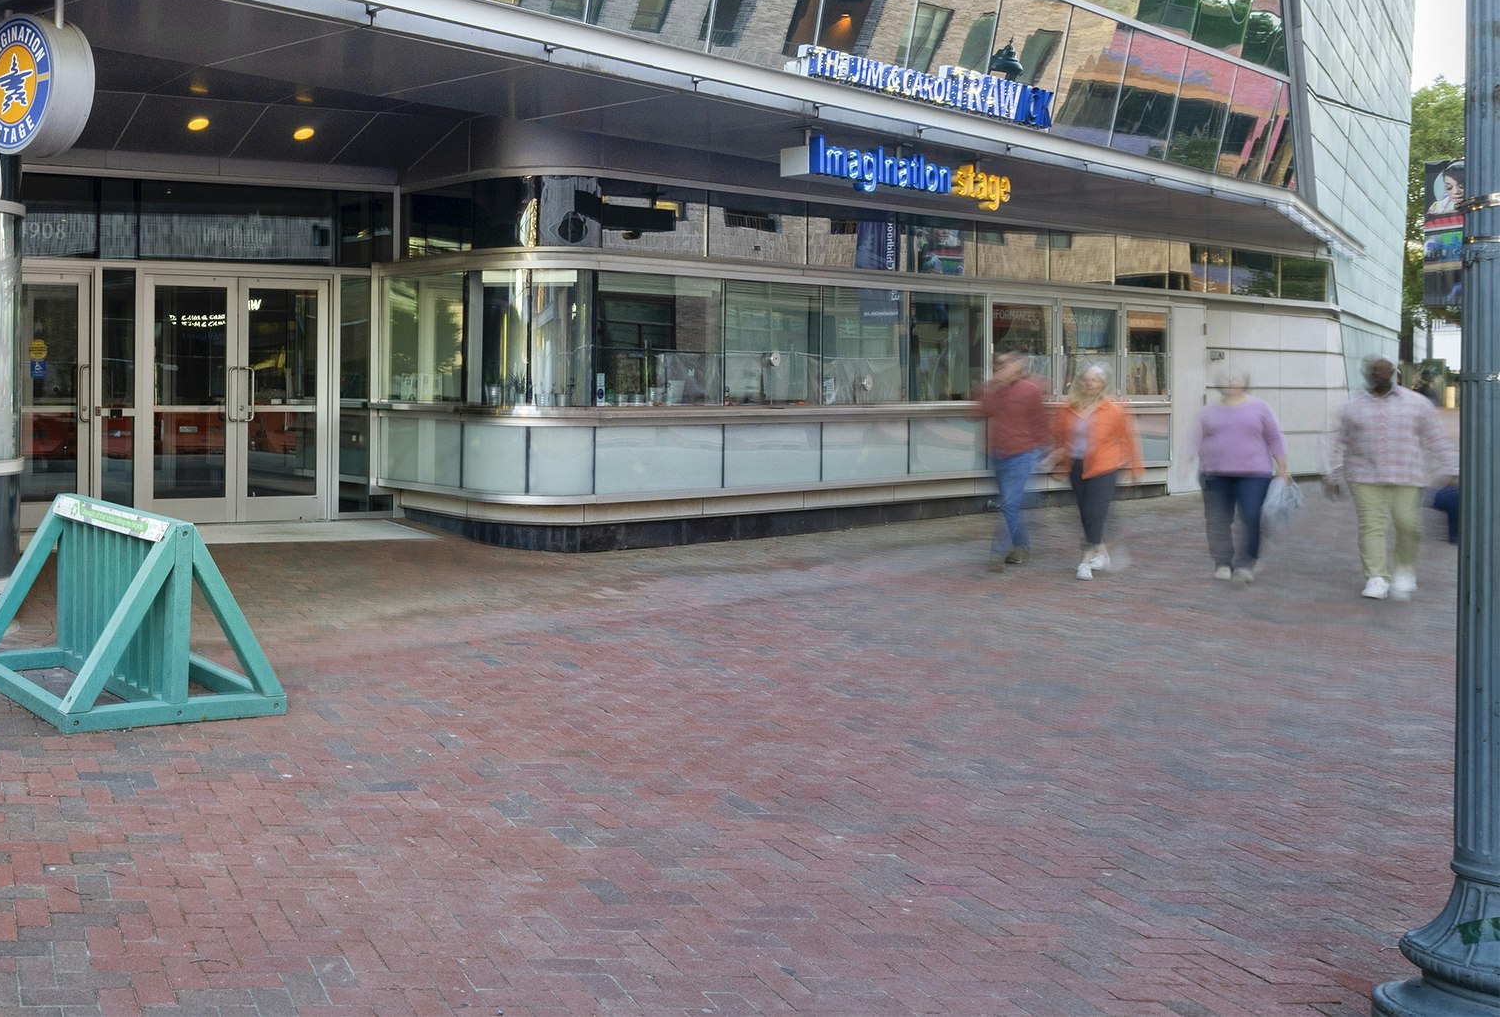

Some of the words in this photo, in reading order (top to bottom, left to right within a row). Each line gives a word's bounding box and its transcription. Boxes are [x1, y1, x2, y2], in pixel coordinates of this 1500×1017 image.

[813, 46, 849, 81] THE
[849, 56, 884, 89] JIM
[885, 65, 901, 93] &
[901, 69, 953, 106] CAROL
[954, 164, 1011, 211] stage
